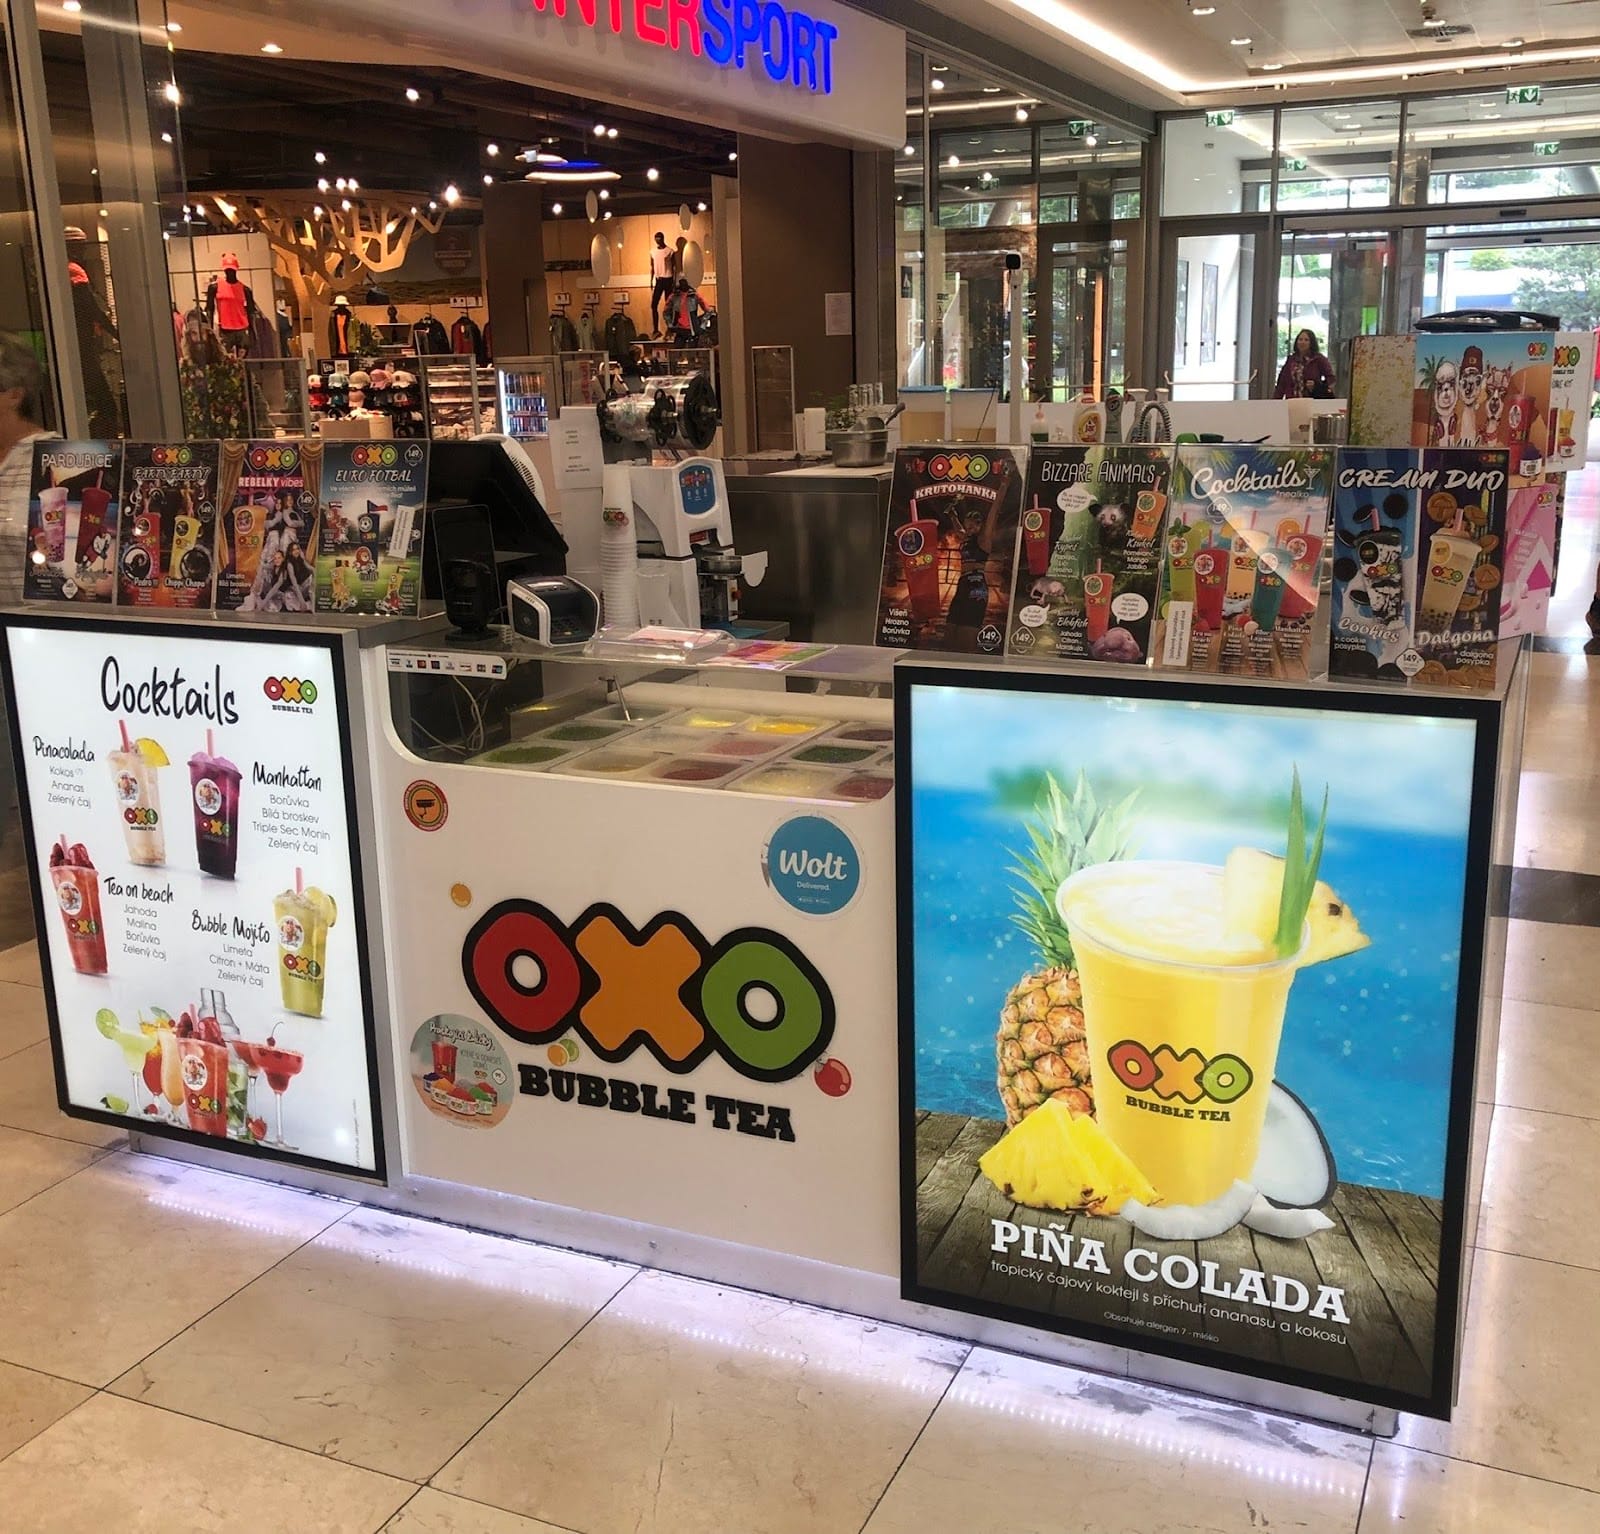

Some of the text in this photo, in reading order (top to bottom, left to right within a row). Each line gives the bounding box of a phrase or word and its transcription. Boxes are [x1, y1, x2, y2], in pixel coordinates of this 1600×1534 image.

[533, 0, 838, 94] ERSPORT
[152, 447, 192, 466] OXO
[249, 447, 298, 470] OXO
[352, 445, 398, 468] OXO
[368, 469, 412, 482] FOTBAL
[928, 453, 991, 481] OXO
[1041, 461, 1156, 483] BIZZARE ANIMALS
[238, 476, 304, 489] REBELKY vibes
[1190, 460, 1306, 500] Cocktails
[1339, 468, 1504, 491] CREAM DUO
[915, 484, 997, 500] KRUTOHANKA
[1339, 618, 1400, 642] Cookies
[1419, 630, 1495, 647] Dalgona
[100, 655, 240, 726] Cocktails
[263, 676, 318, 704] OXO
[272, 704, 314, 714] BUBBLE TEA
[32, 735, 96, 762] Pinacolada
[49, 765, 74, 778] Kokos
[252, 761, 322, 792] Manhattan
[52, 780, 85, 793] Ananas
[48, 792, 92, 810] Zelený čaj
[270, 794, 310, 808] Borůvka
[124, 807, 158, 825] OXO
[262, 807, 319, 824] Bílá broskev
[201, 818, 232, 836] OXO
[252, 821, 331, 841] Triple Sec Monin
[268, 837, 319, 855] Zelený čaj
[780, 850, 848, 880] Wolt
[104, 877, 175, 904] Tea on beach
[124, 904, 158, 918] Jahoda
[68, 918, 99, 935] OXO
[126, 918, 158, 932] Malina
[192, 909, 271, 948] Bubble Mojito
[126, 930, 161, 946] Borůvka
[123, 943, 167, 962] Zelený čaj
[222, 944, 254, 958] Limeta
[209, 954, 237, 969] Citron
[245, 960, 270, 974] Máta
[283, 953, 321, 978] OXO
[218, 969, 264, 988] Zelený čaj
[462, 898, 836, 1083] OXO
[1107, 1040, 1254, 1104] OXO
[190, 1093, 221, 1112] OXO
[518, 1063, 796, 1142] BUBBLE TEA
[1126, 1095, 1231, 1122] BUBBLE TEA
[990, 1218, 1352, 1324] PIÑA COLADA
[992, 1259, 1347, 1344] tropický čajový koktejl s příchutí ananasu a kokosu
[1104, 1311, 1145, 1327] Obsahuje
[1146, 1320, 1180, 1334] alergen
[1181, 1328, 1188, 1336] 7
[1192, 1331, 1220, 1343] mléko
